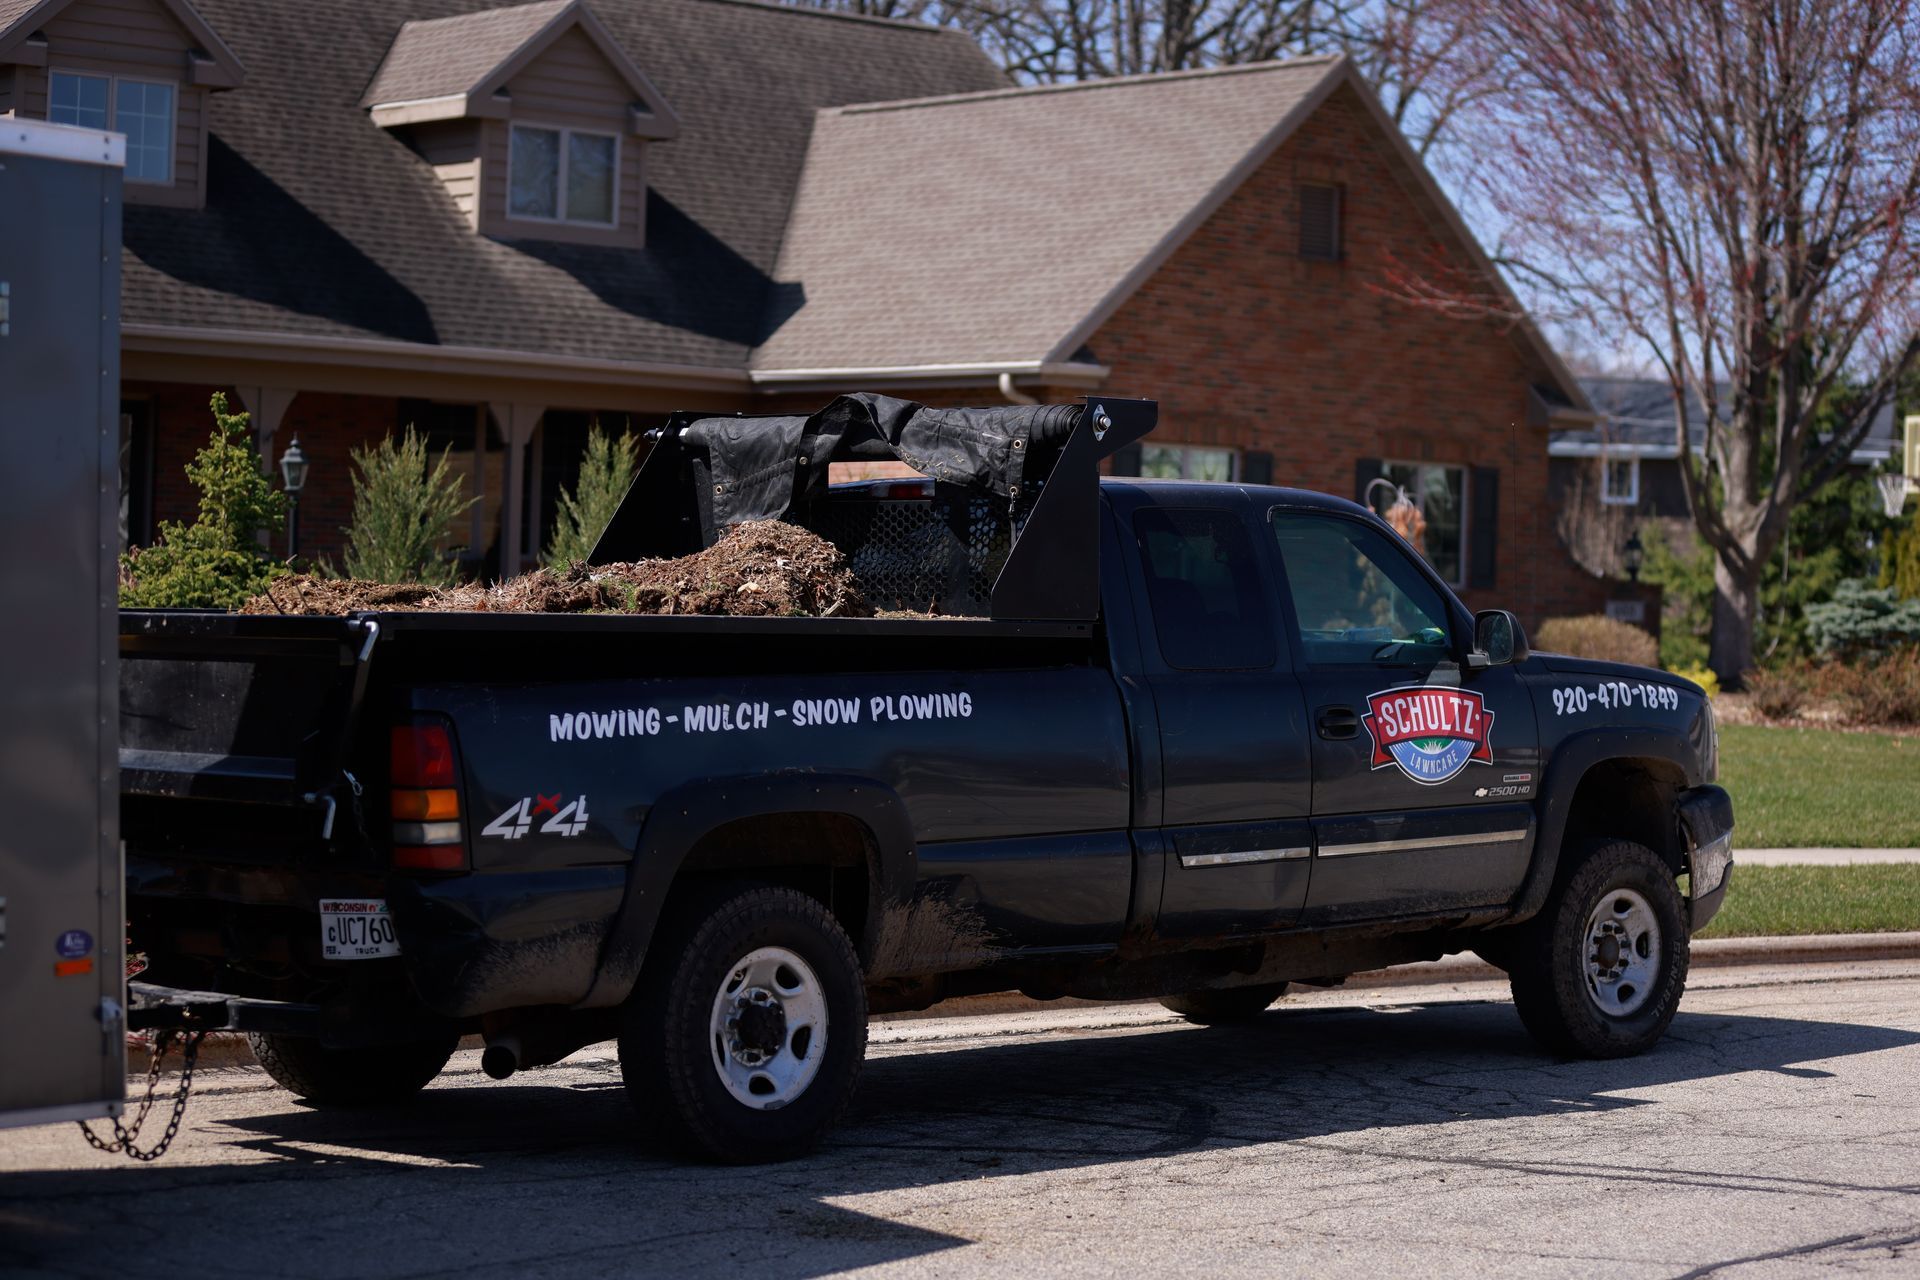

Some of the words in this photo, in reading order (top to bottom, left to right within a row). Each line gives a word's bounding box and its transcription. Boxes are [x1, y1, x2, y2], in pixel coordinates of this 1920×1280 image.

[1553, 682, 1678, 715] 920-470-1849
[550, 707, 660, 742] MOWING
[685, 702, 769, 733] MULCH
[792, 697, 860, 726] SNOW
[870, 692, 972, 721] PLOWING
[1381, 695, 1474, 737] SCHULTZ
[1410, 749, 1459, 774] LAWNCARE
[1488, 787, 1518, 797] 2500
[322, 903, 368, 913] WISCONSIN
[355, 947, 381, 955] TRUCK
